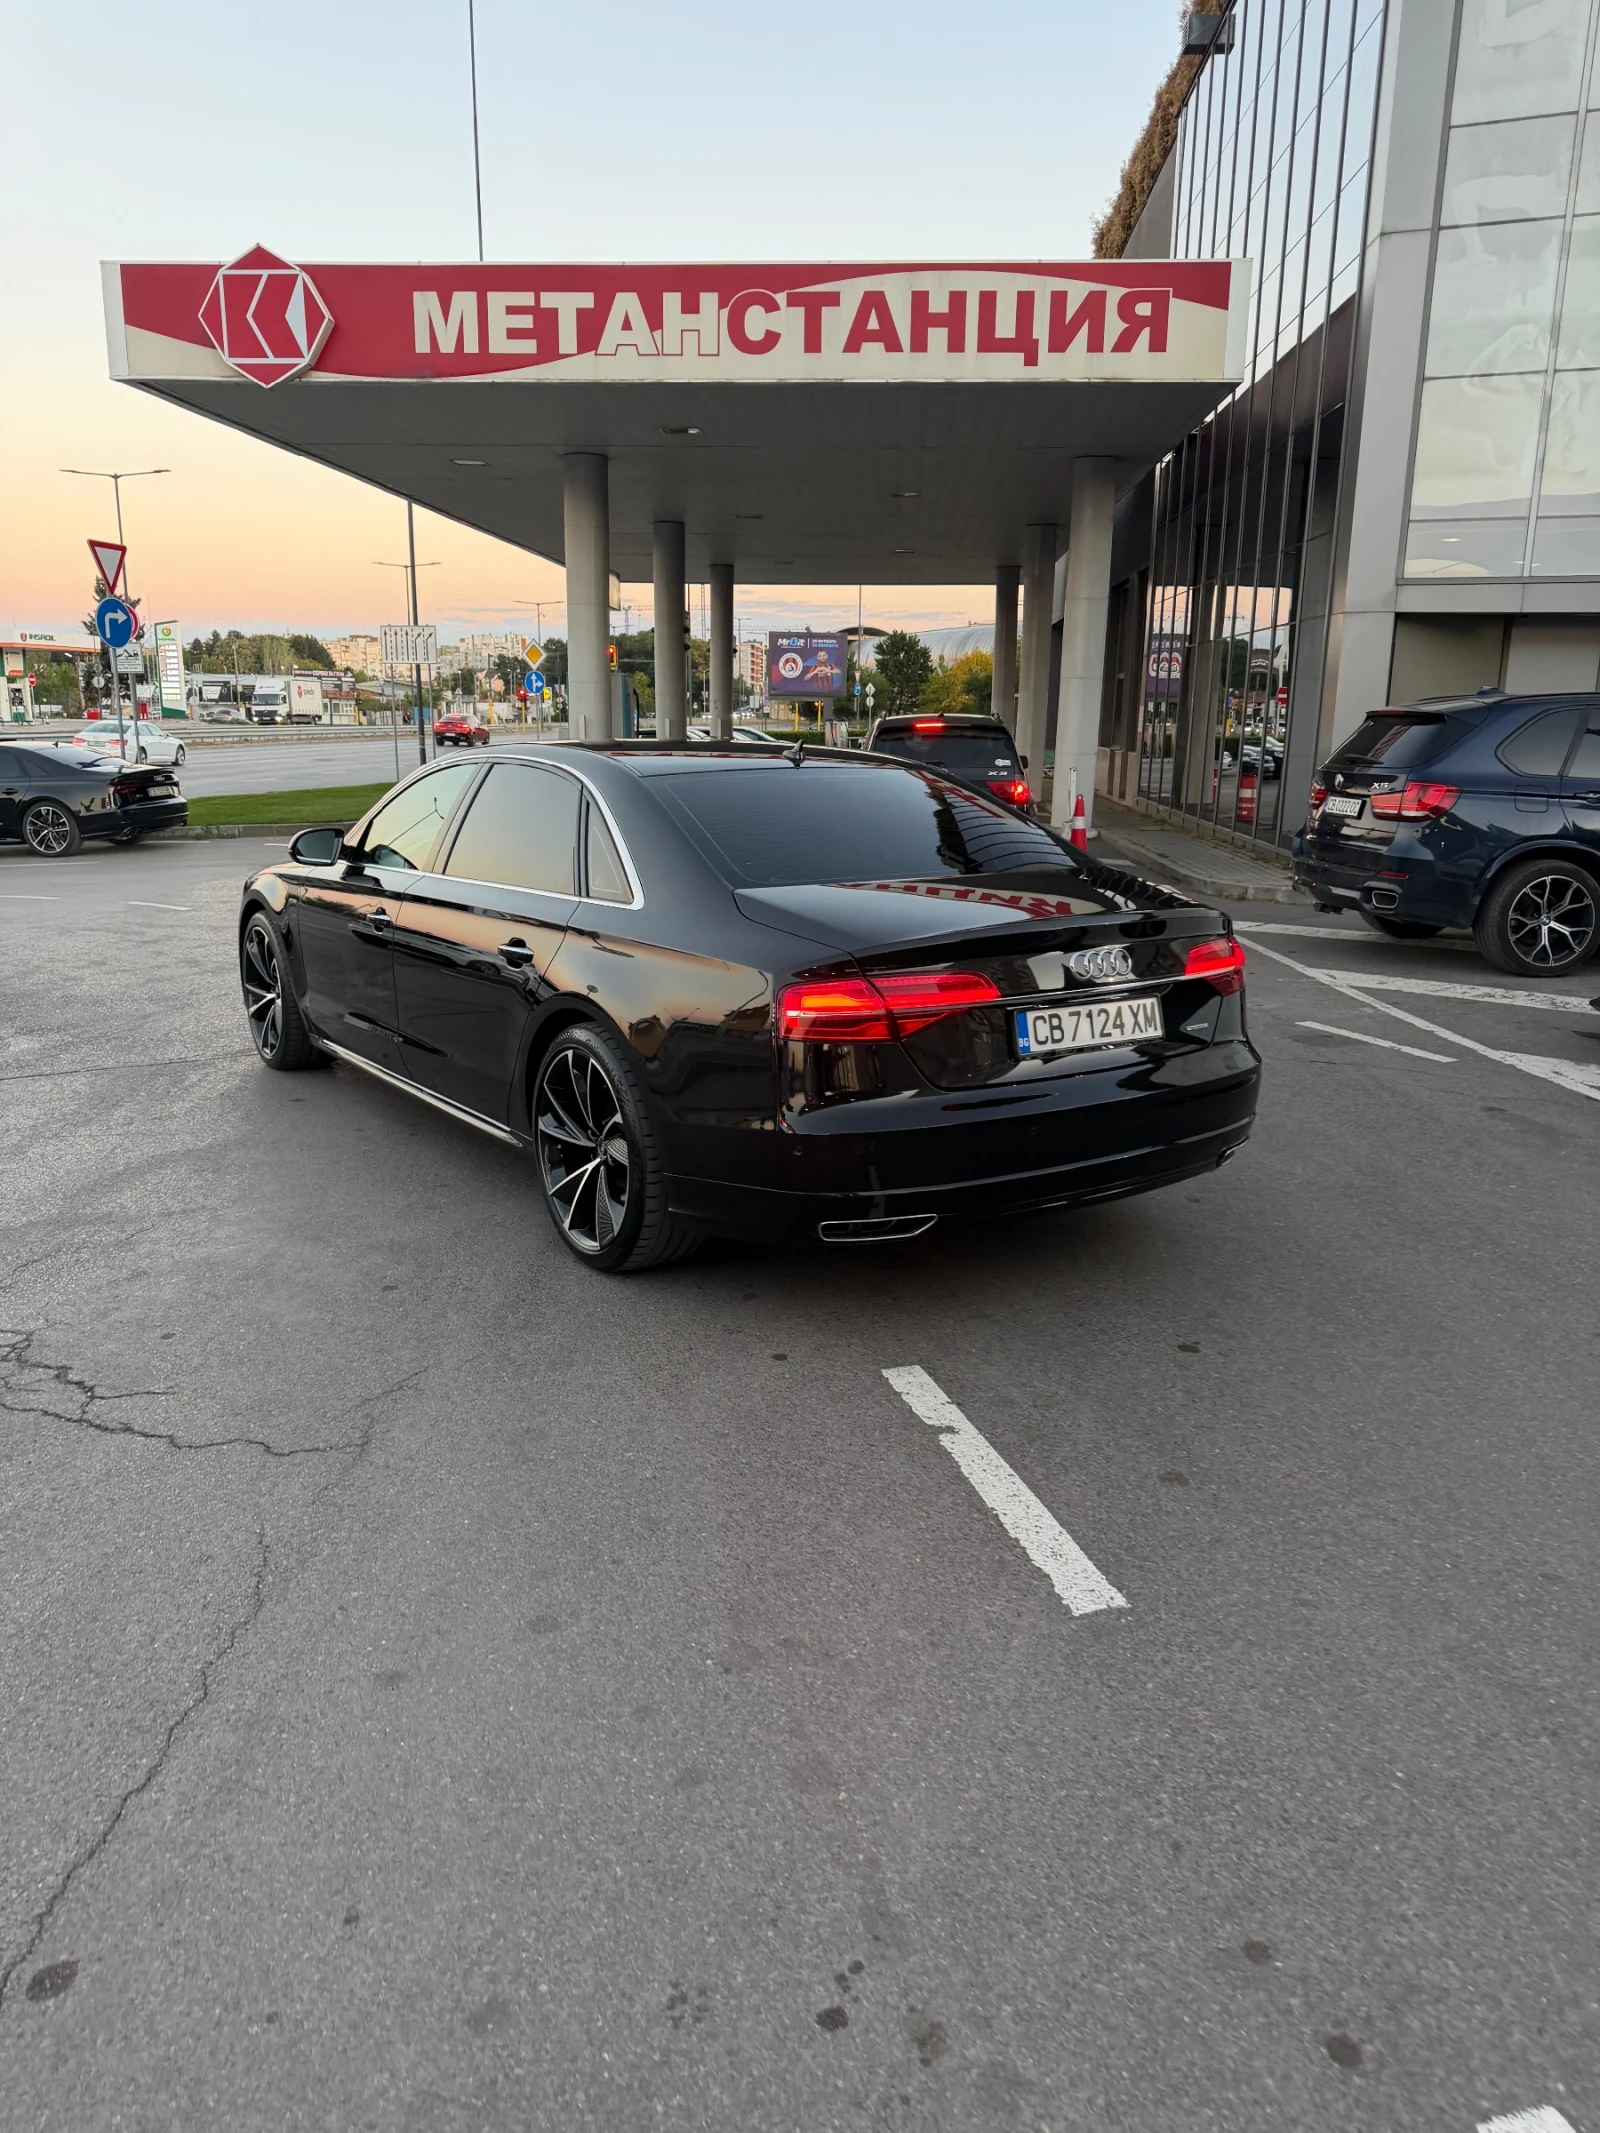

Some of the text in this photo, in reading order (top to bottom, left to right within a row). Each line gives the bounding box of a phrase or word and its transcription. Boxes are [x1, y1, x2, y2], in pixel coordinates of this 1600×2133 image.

[413, 289, 1171, 366] МЕТАНСТАНЦИЯ
[777, 637, 806, 647] MrBit
[1032, 1002, 1158, 1046] CB 7124 XM
